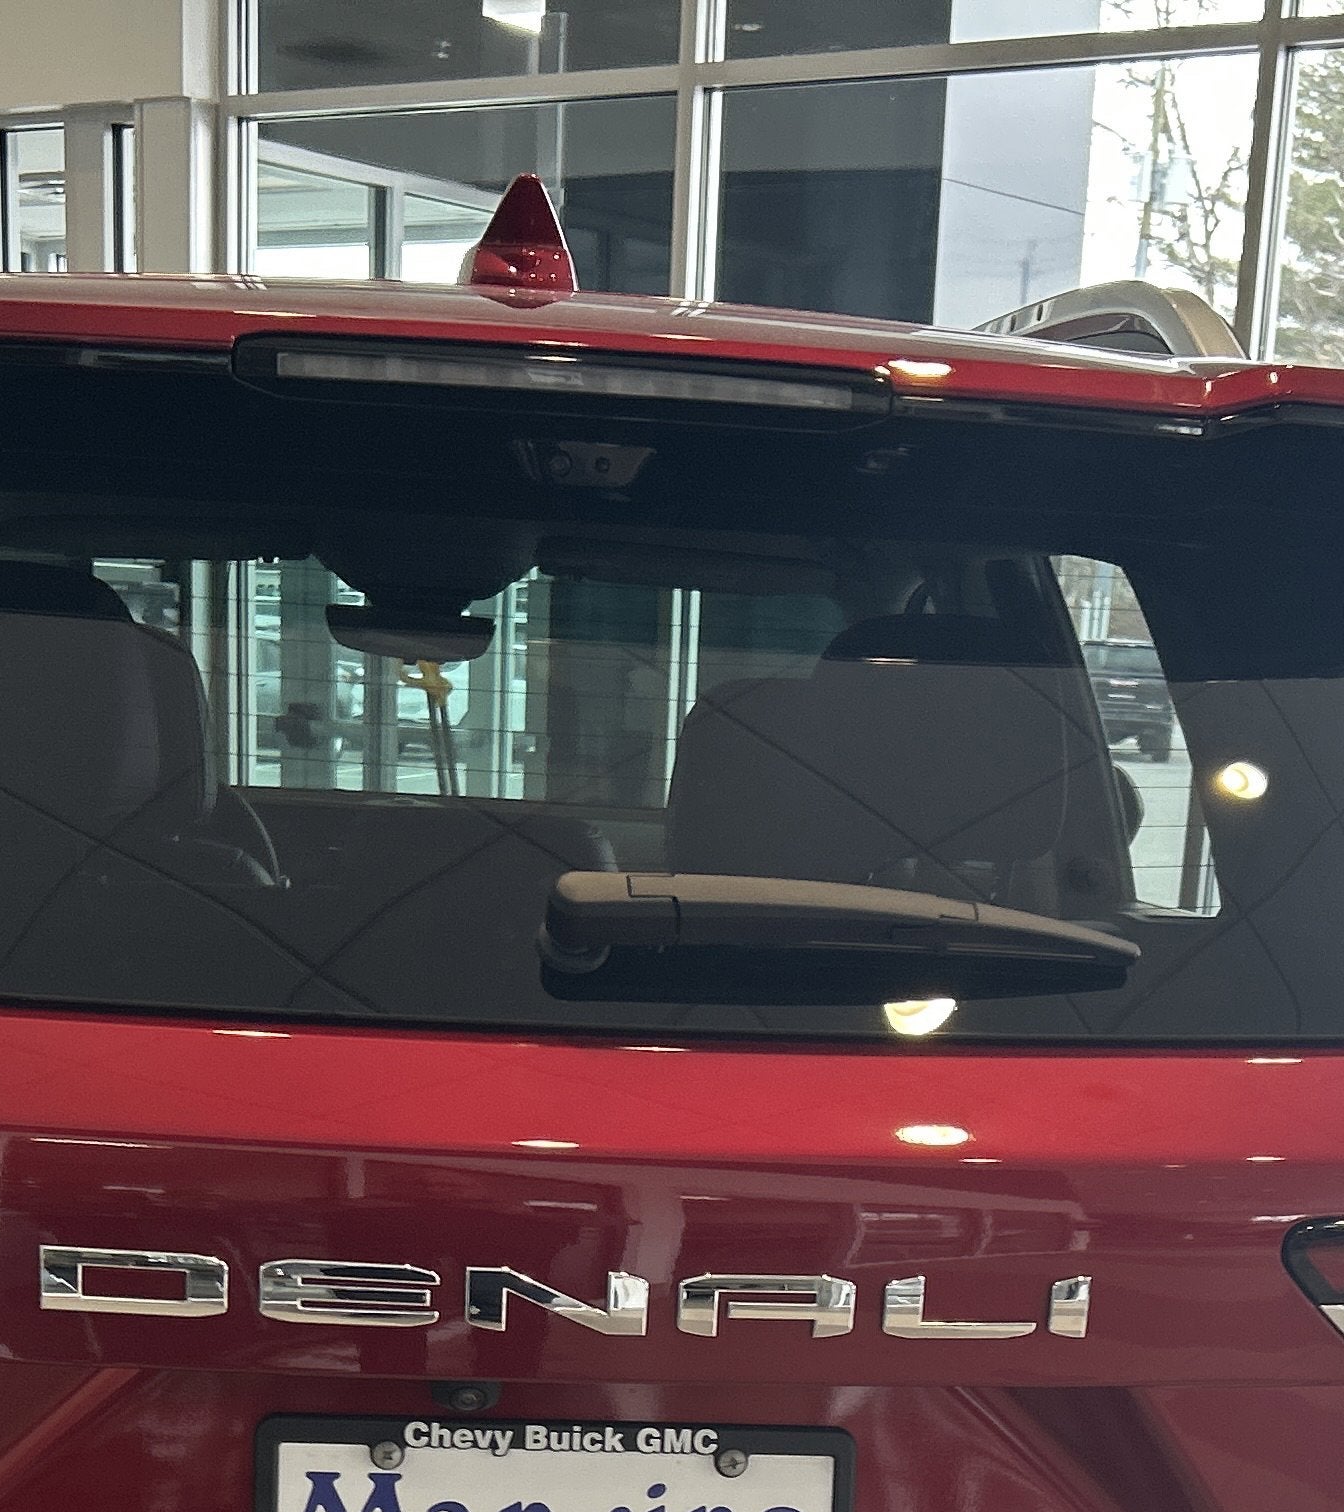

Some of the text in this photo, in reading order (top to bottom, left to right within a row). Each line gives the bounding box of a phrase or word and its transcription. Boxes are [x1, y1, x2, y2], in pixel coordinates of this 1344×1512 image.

[39, 1244, 1091, 1340] DENALI
[404, 1421, 719, 1455] Chevy Buick GMC
